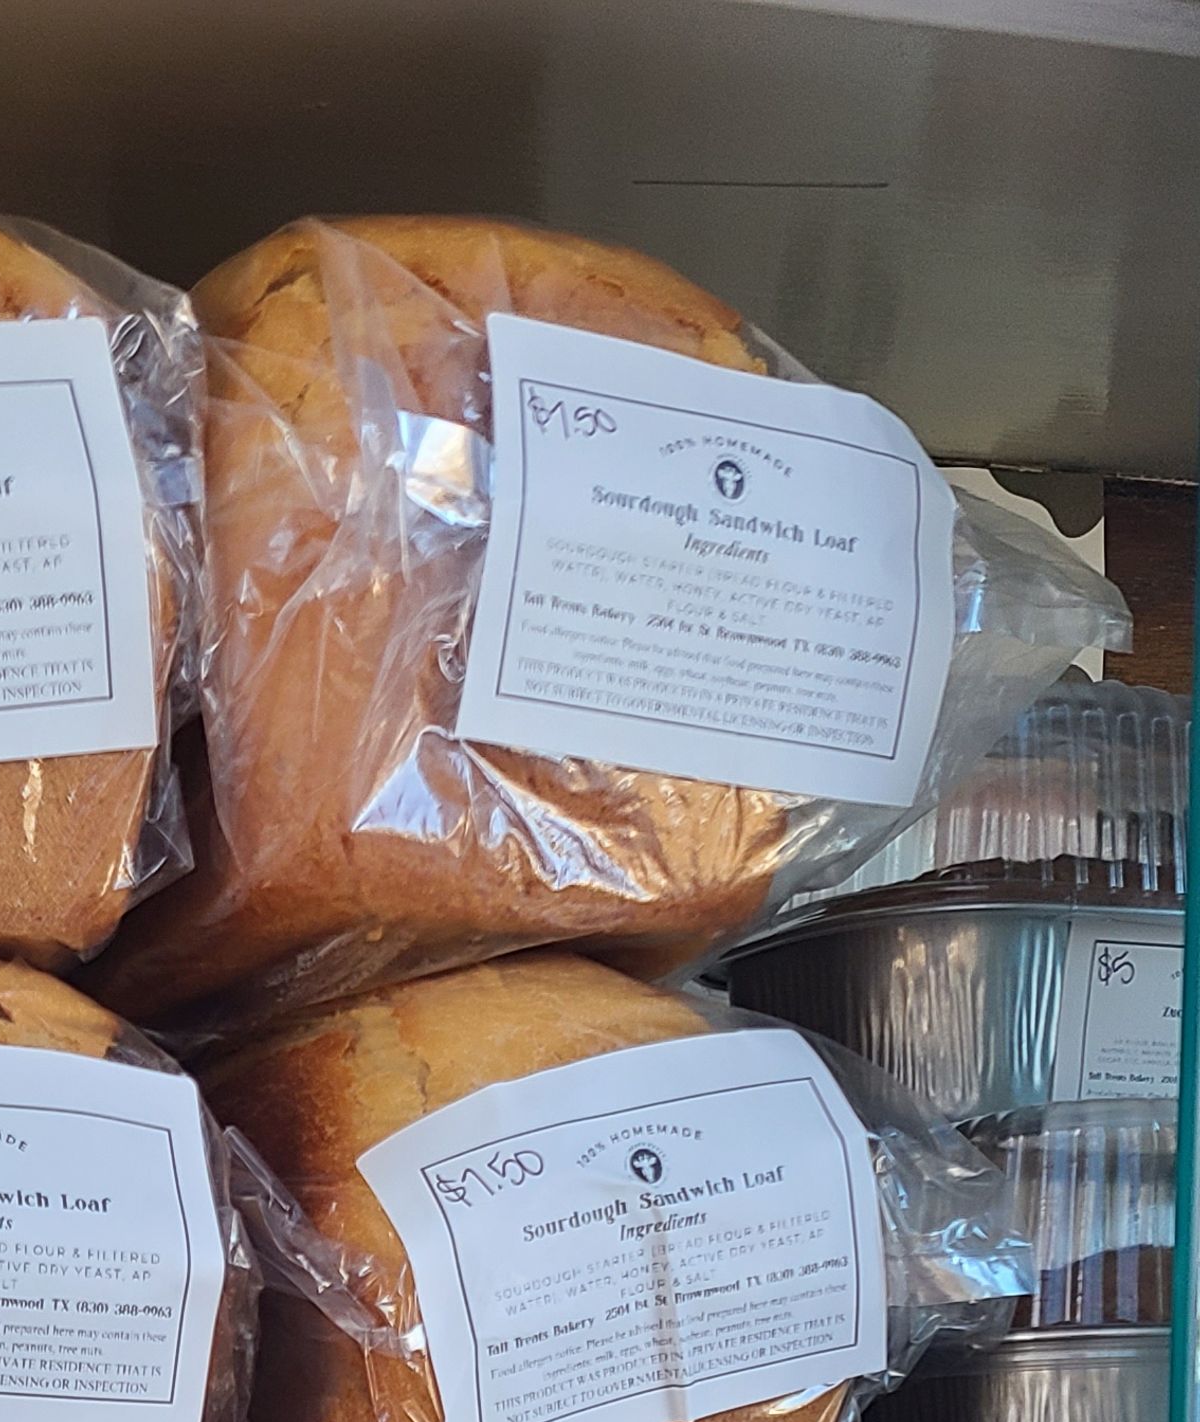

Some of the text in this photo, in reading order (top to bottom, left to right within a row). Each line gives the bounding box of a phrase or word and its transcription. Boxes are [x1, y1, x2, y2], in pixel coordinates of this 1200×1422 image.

[703, 435, 792, 477] HOMEMADE
[590, 484, 859, 553] Sourdough Sandwich Loaf
[682, 531, 770, 564] Ingredients
[1098, 947, 1135, 986] $5
[609, 1124, 703, 1143] HOMEMADE
[59, 1192, 111, 1213] Loaf
[521, 1164, 784, 1242] Sourdough Sandwich Loaf
[619, 1211, 707, 1241] Ingredients
